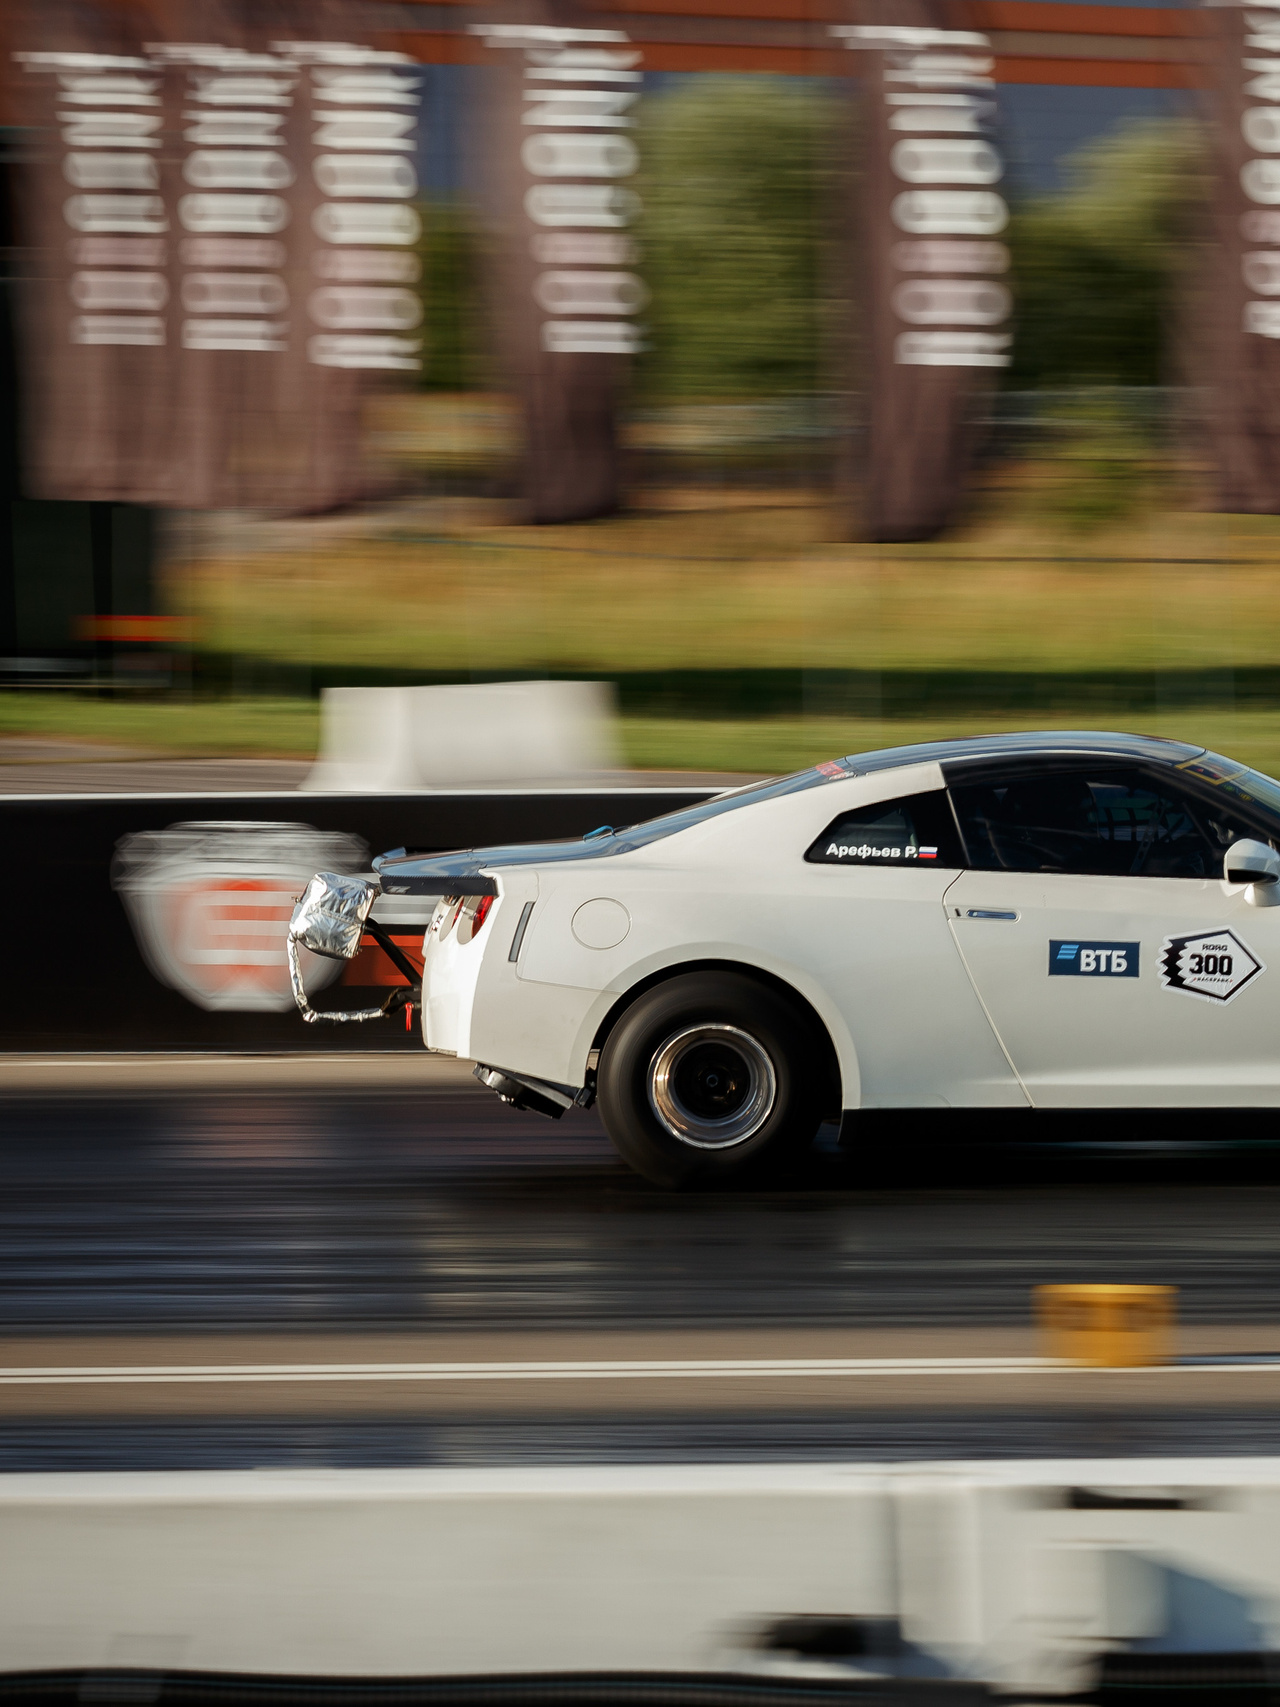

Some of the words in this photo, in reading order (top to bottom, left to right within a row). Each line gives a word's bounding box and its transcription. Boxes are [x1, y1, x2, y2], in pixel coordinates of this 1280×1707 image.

[826, 843, 901, 859] Арефьев
[1080, 949, 1128, 973] ВТБ
[1189, 953, 1233, 976] 300
